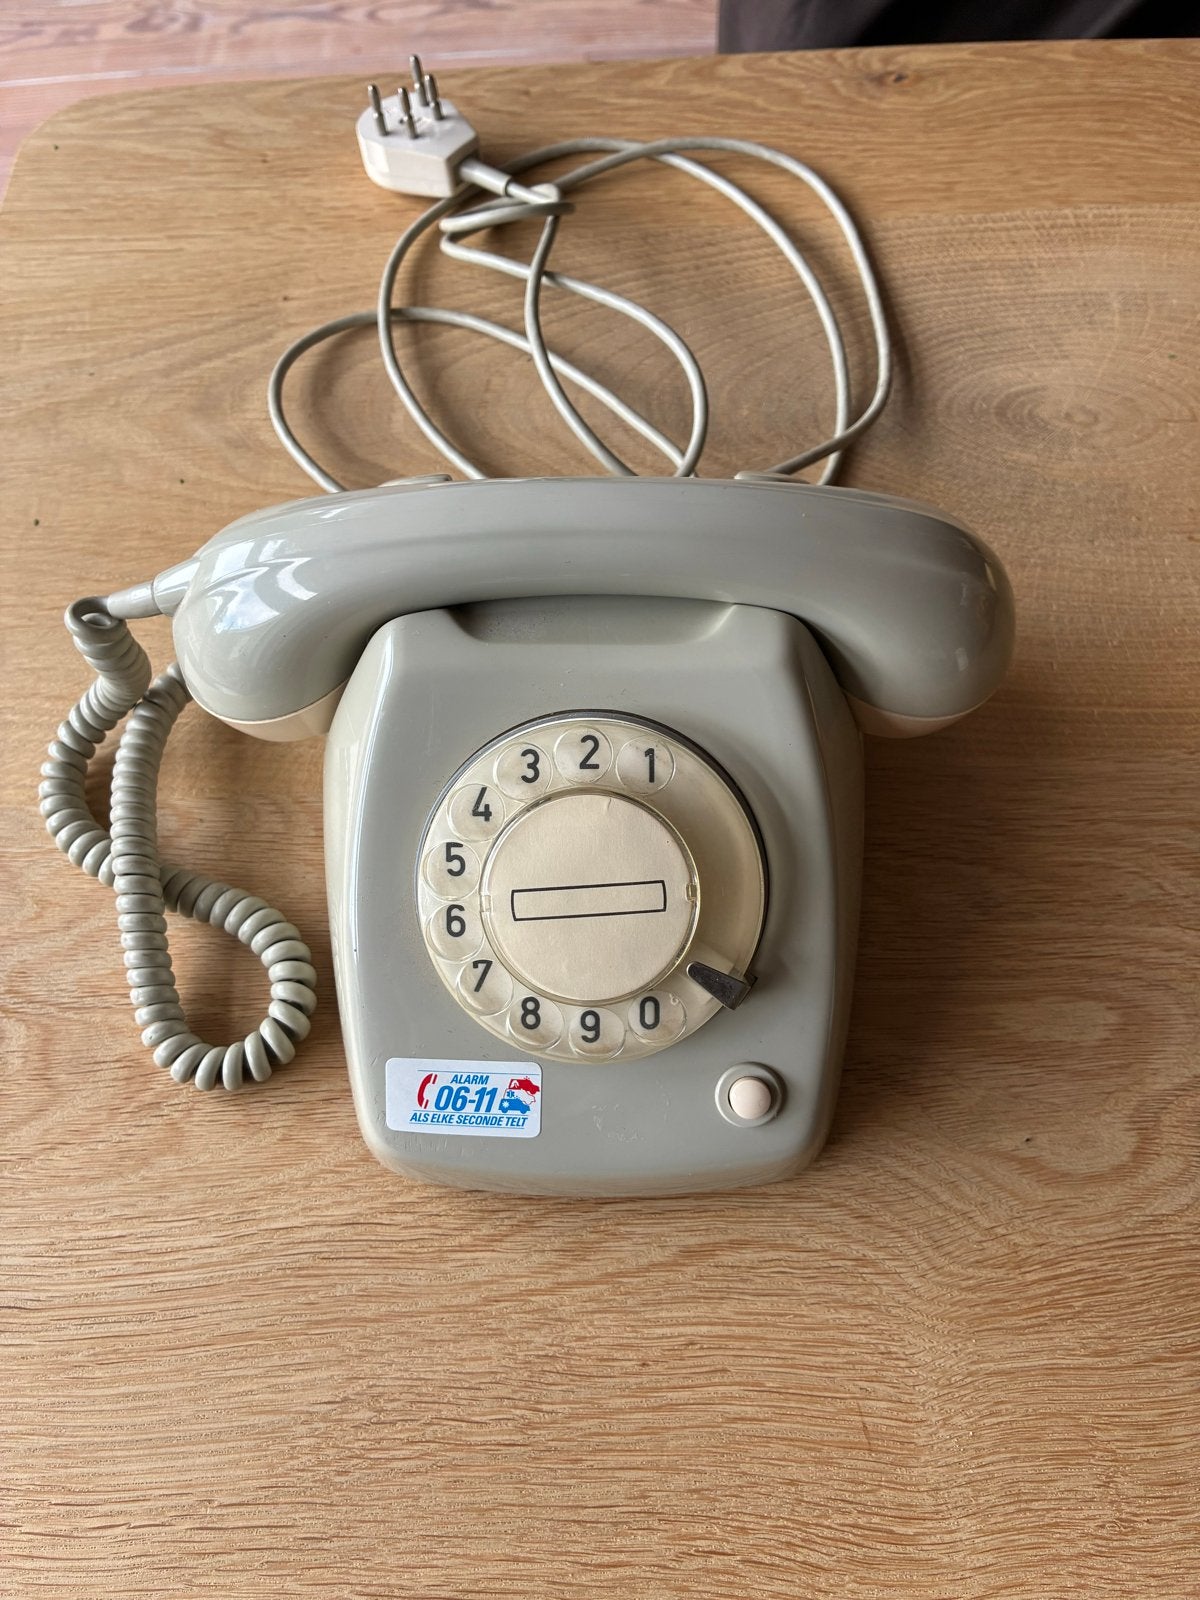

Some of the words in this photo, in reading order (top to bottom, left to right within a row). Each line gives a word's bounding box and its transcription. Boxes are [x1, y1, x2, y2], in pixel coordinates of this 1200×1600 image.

[521, 749, 539, 783] 3
[580, 735, 600, 769] 2
[645, 748, 655, 783] 1
[472, 787, 492, 821] 4
[446, 842, 465, 876] 5
[447, 904, 465, 937] 6
[473, 960, 492, 992] 7
[521, 996, 541, 1030] 8
[580, 1010, 600, 1043] 9
[639, 996, 660, 1030] 0
[450, 1074, 489, 1085] ALARM
[434, 1086, 498, 1112] 06-11
[410, 1113, 429, 1122] ALS
[430, 1114, 454, 1123] ELKE
[456, 1115, 505, 1126] SECONDE
[506, 1117, 528, 1127] TELT
